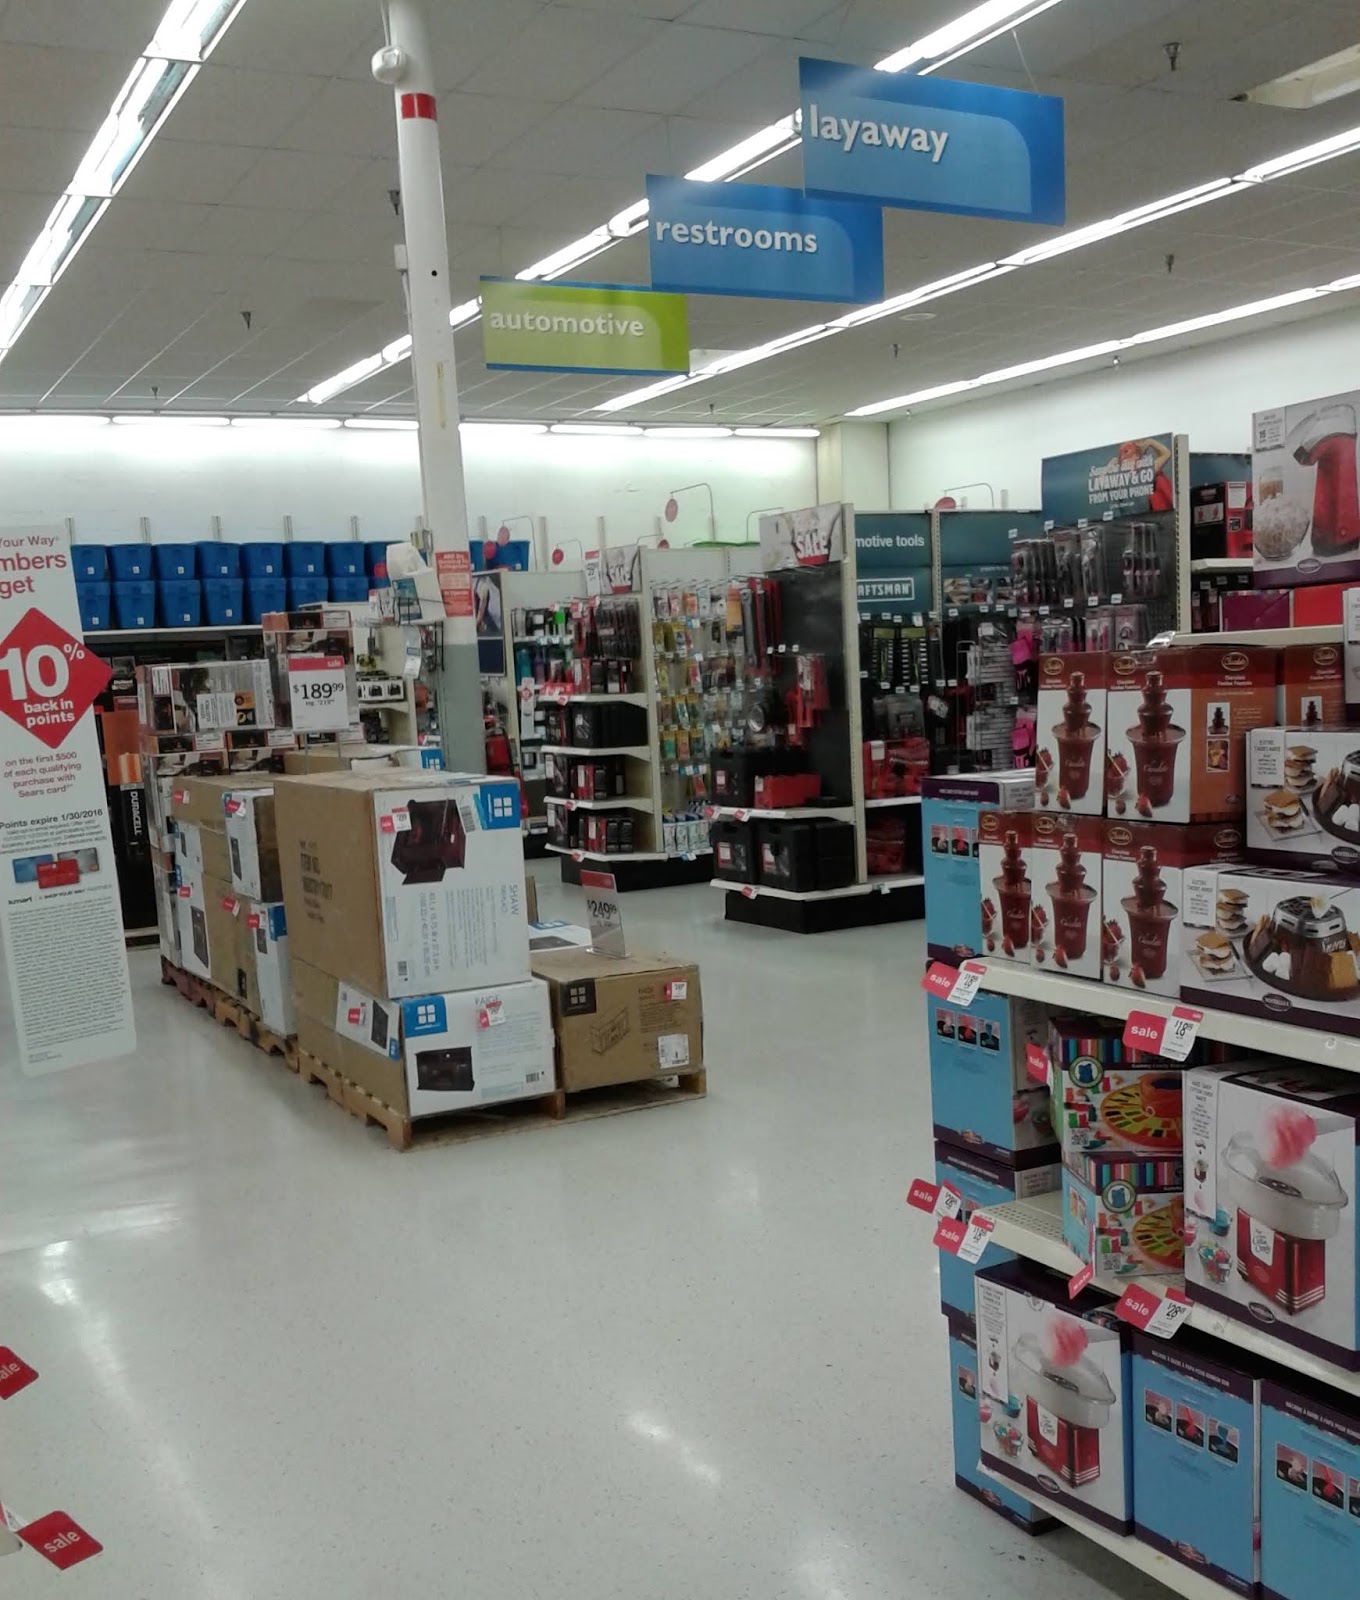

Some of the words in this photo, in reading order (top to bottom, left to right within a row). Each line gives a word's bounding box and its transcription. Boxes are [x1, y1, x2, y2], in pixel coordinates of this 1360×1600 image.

[809, 104, 948, 163] layaway
[655, 218, 818, 254] restrooms
[489, 311, 645, 337] automotive
[1088, 473, 1131, 492] LAYAWAY
[1140, 468, 1154, 483] GO
[1089, 491, 1108, 504] FROM
[1109, 488, 1128, 500] YOUR
[1129, 484, 1154, 497] PHONE
[0, 538, 24, 548] our
[896, 534, 925, 547] tools
[0, 576, 35, 599] get
[24, 700, 58, 713] back
[61, 699, 73, 709] in
[26, 712, 75, 728] points
[20, 757, 33, 765] the
[36, 755, 53, 763] first
[56, 752, 77, 761] $500
[4, 770, 13, 778] of
[15, 768, 37, 777] each
[40, 763, 81, 775] qualifying
[13, 777, 54, 789] purchase
[57, 774, 75, 782] with
[19, 788, 44, 797] Sears
[130, 791, 142, 835] DURACELL
[0, 821, 27, 829] Points
[31, 816, 58, 826] expire
[930, 974, 950, 988] sale
[1131, 1025, 1158, 1039] sale
[913, 1189, 932, 1202] sale
[940, 1229, 960, 1243] sale
[1125, 1298, 1149, 1316] sale
[44, 1530, 81, 1553] sale
